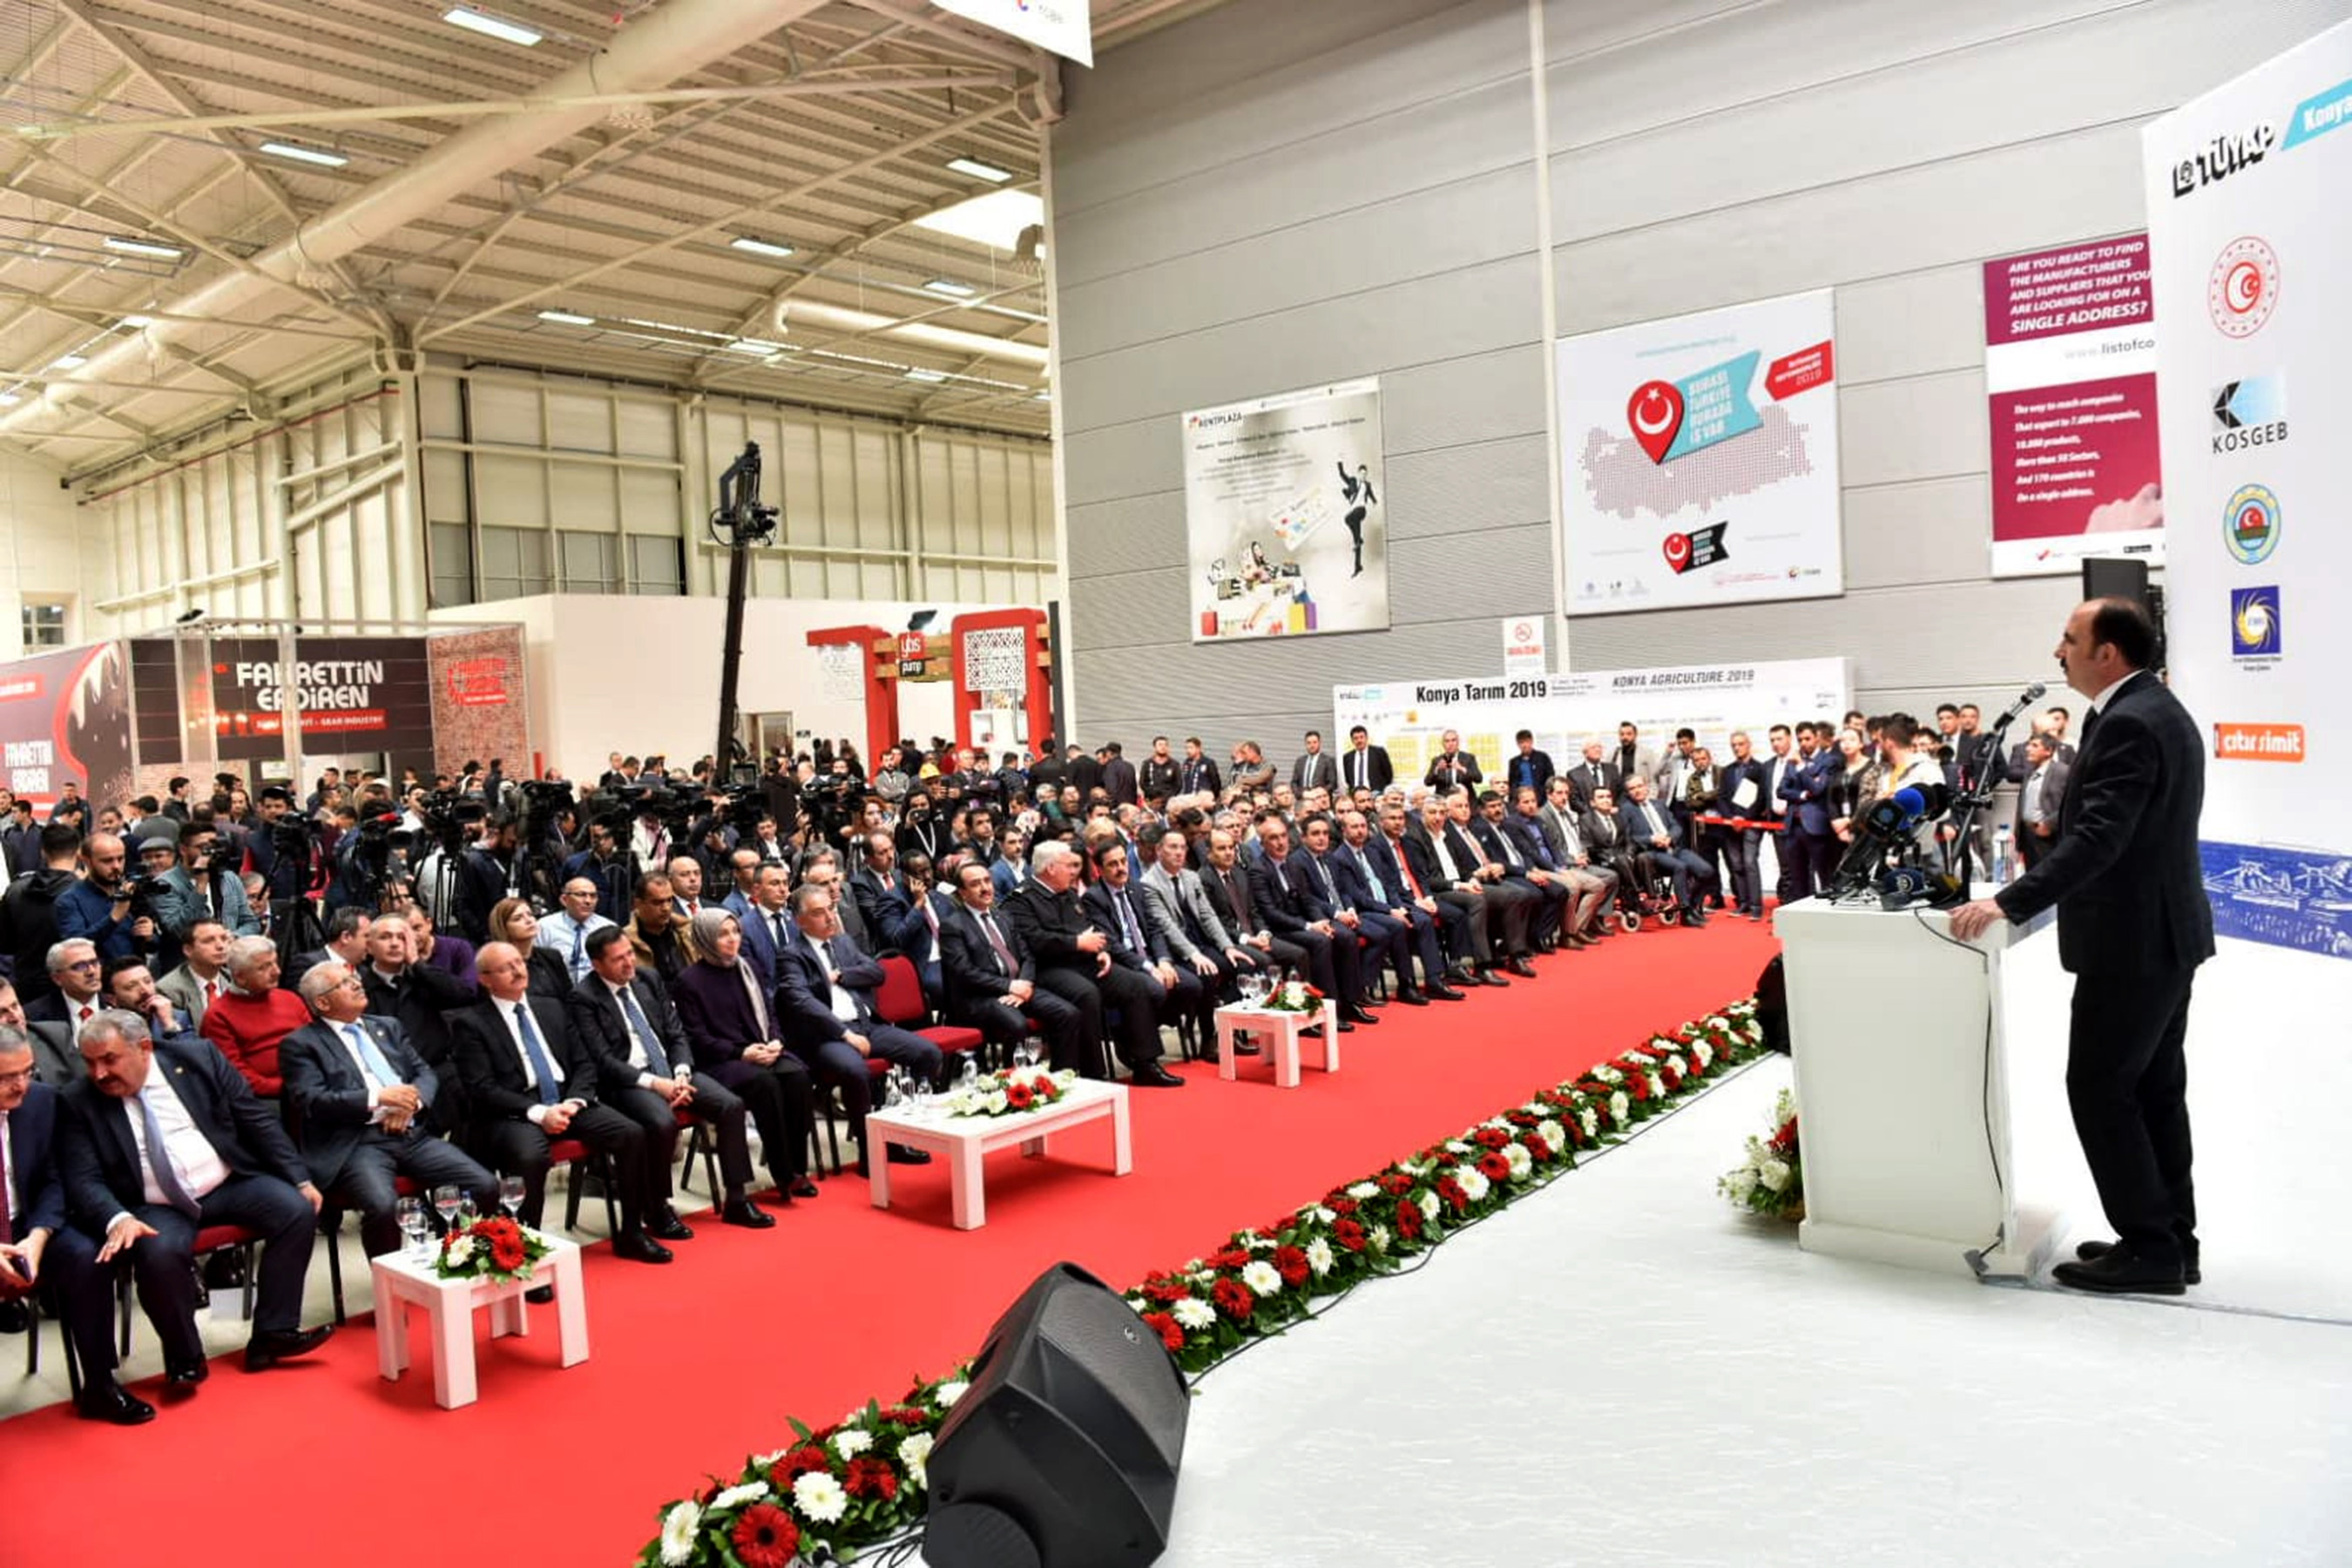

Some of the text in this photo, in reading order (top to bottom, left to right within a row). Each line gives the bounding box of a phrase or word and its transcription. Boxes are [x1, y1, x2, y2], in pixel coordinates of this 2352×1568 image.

[2009, 242, 2144, 273] ARE YOU READY TO FIND
[2010, 259, 2132, 287] THE MANUFACTURERS
[2010, 269, 2152, 301] AND SUPPLIERS THAT YOU
[2010, 287, 2142, 315] ARE LOOKING FOR ON A
[2011, 301, 2149, 334] SINGLE ADDRESS?
[2212, 421, 2288, 455] KOSGEB
[1416, 686, 1460, 706] Konya
[1464, 683, 1505, 701] Tarım
[1510, 680, 1546, 699] 2019
[1612, 674, 1646, 688] KONYA
[1650, 671, 1725, 686] AGRICULTURE
[1727, 669, 1754, 682] 2019
